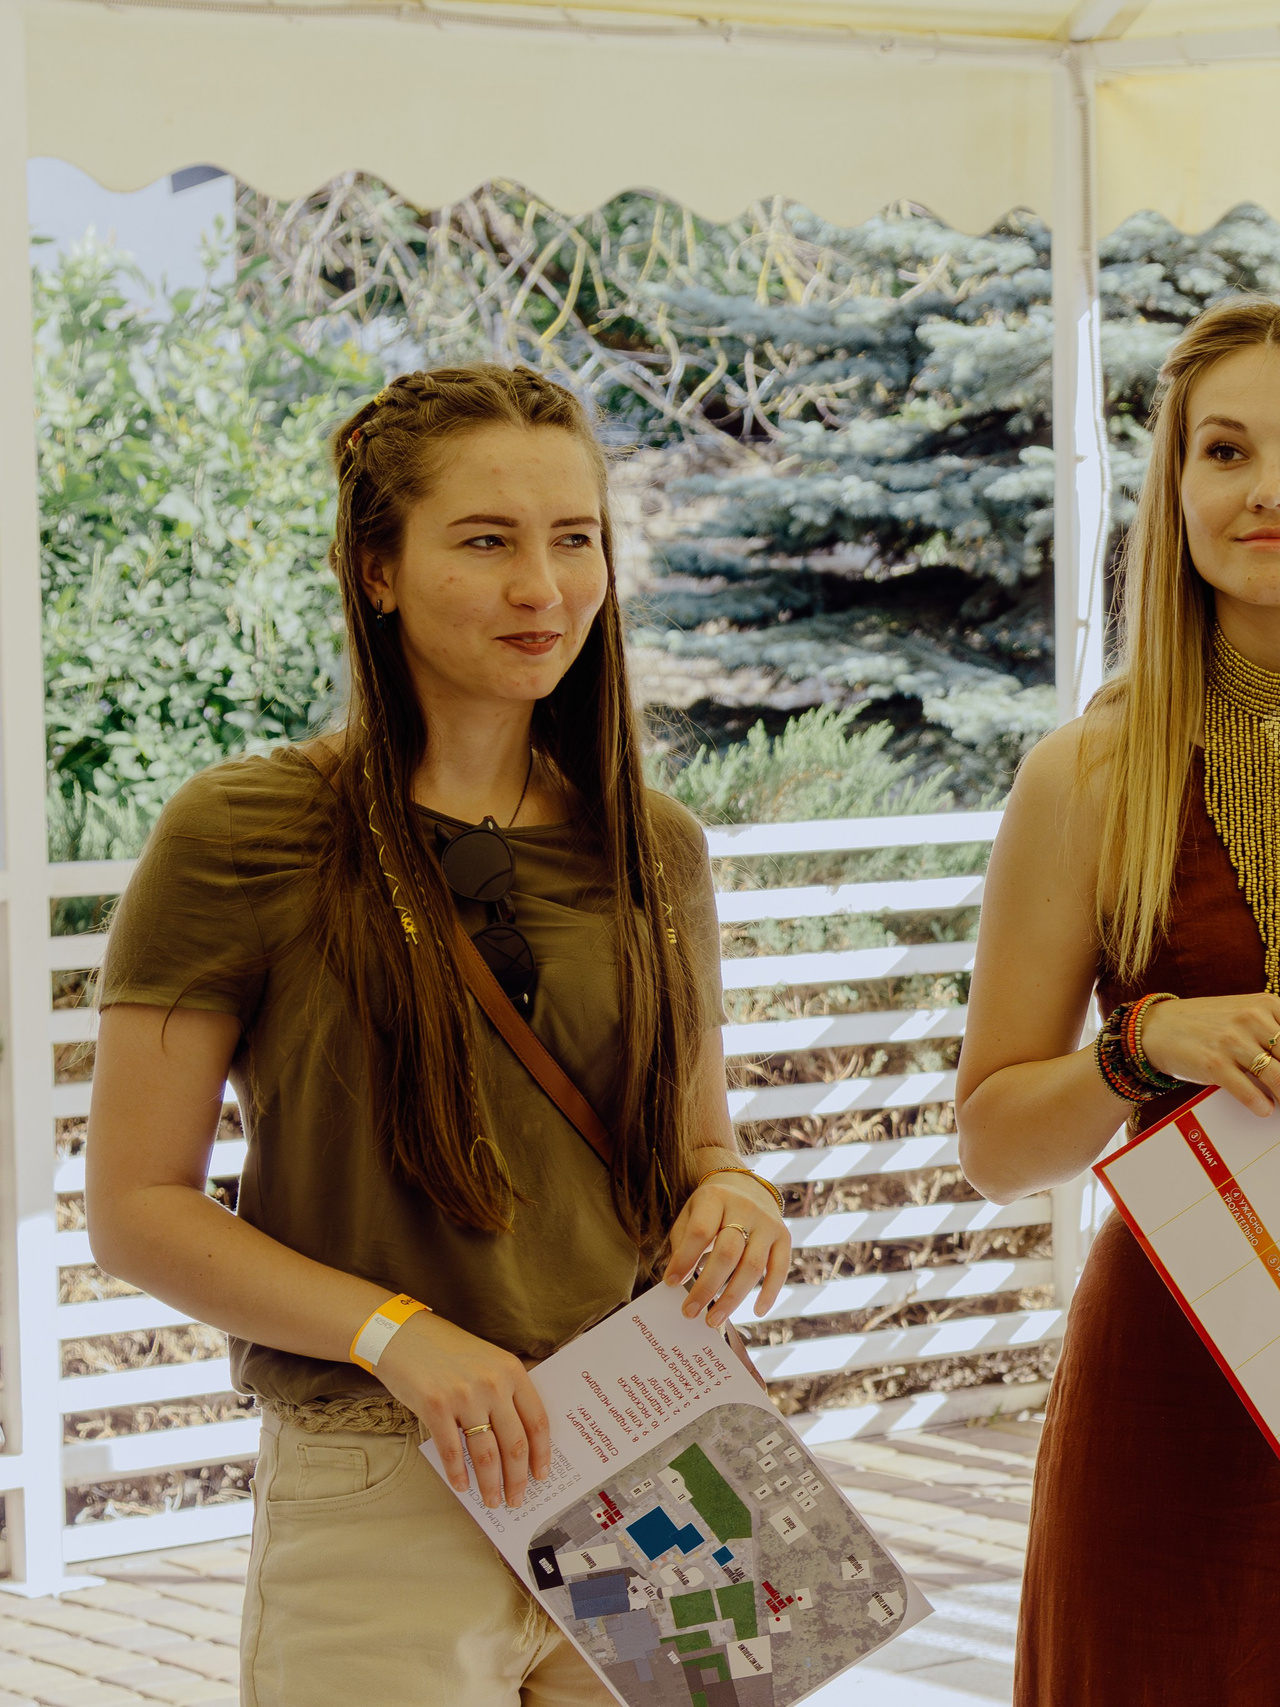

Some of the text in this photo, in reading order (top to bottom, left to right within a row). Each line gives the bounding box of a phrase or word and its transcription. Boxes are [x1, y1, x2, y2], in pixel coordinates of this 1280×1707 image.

[1196, 1141, 1217, 1168] КАНАТ
[1221, 1192, 1259, 1247] ТРОГАТЕЛЬНО
[1237, 1198, 1264, 1235] УЖАСНО
[630, 1313, 701, 1401] 4. УЖАСНО ТРОГАТЕЛЬНО
[670, 1344, 711, 1394] 5. РЕЗИНОЧКИ
[691, 1351, 722, 1387] 6. НА ЛБУ
[701, 1343, 732, 1380] 7. ДА/НЕТ
[579, 1368, 640, 1443] 8. УГАДАЙ МЕЛОДИЮ
[616, 1375, 660, 1429] 10. РАСКРАСКА
[630, 1373, 670, 1422] 1. МЕДИТАЦИЯ
[646, 1374, 680, 1416] 2. ТАРОЛОГ
[662, 1375, 691, 1408] 3. КАНАТ
[564, 1407, 610, 1464] ВАШ МАРШРУТ,
[575, 1403, 619, 1457] СЛЕДУЙТЕ ЕМУ:
[624, 1406, 650, 1436] 9. КЛИП
[552, 1445, 574, 1472] ЛАВКА
[465, 1484, 487, 1511] ФЕСТИ
[642, 1480, 651, 1488] 12
[483, 1507, 506, 1534] СХЕМА
